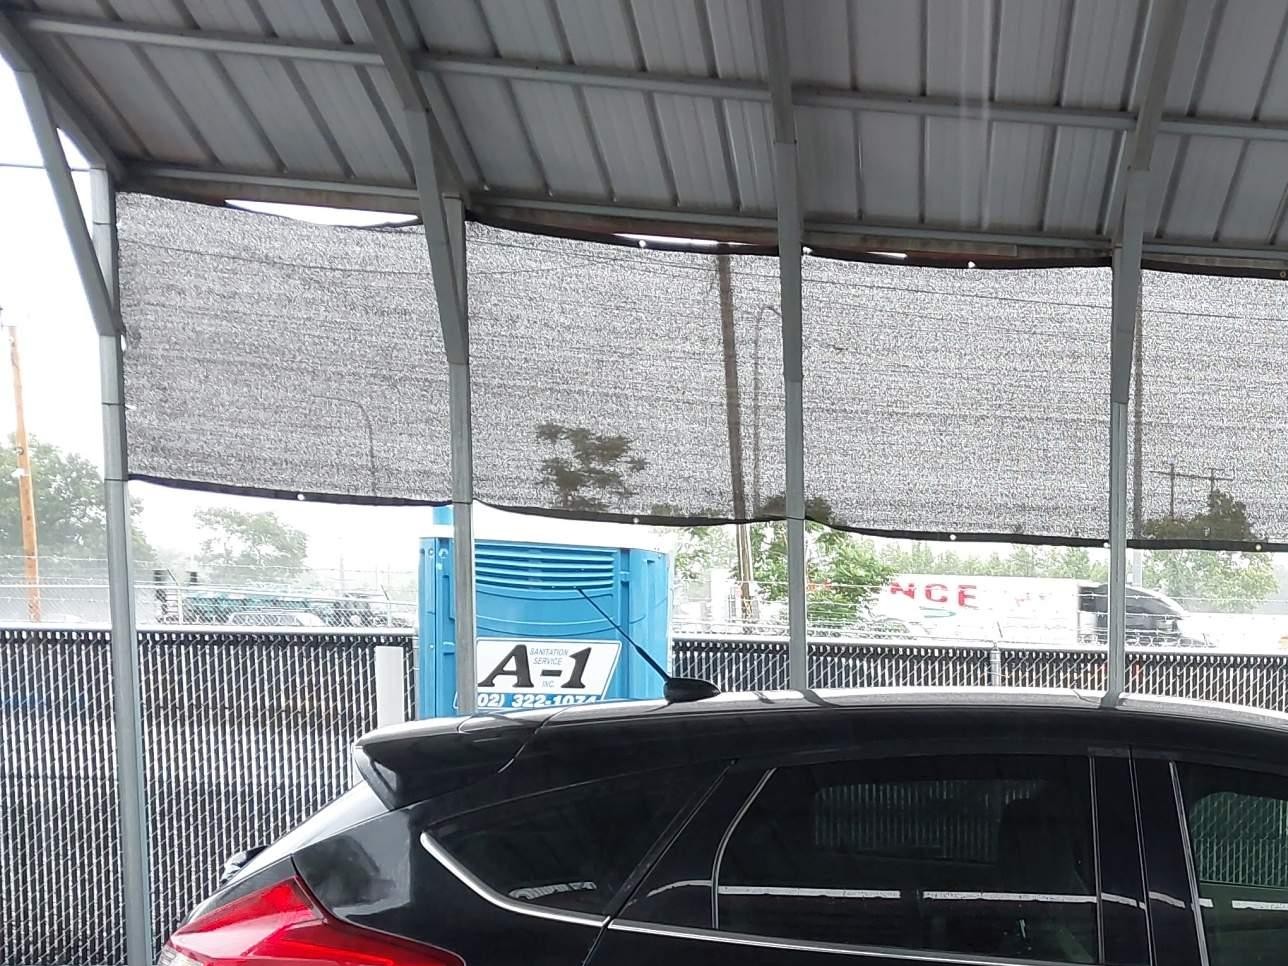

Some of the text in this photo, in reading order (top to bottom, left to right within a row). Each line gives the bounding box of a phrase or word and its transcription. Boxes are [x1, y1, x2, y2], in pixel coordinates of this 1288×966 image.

[530, 647, 568, 656] SANITATION
[478, 644, 592, 689] A-1
[534, 657, 562, 665] SERVICE
[478, 693, 505, 707] 02)
